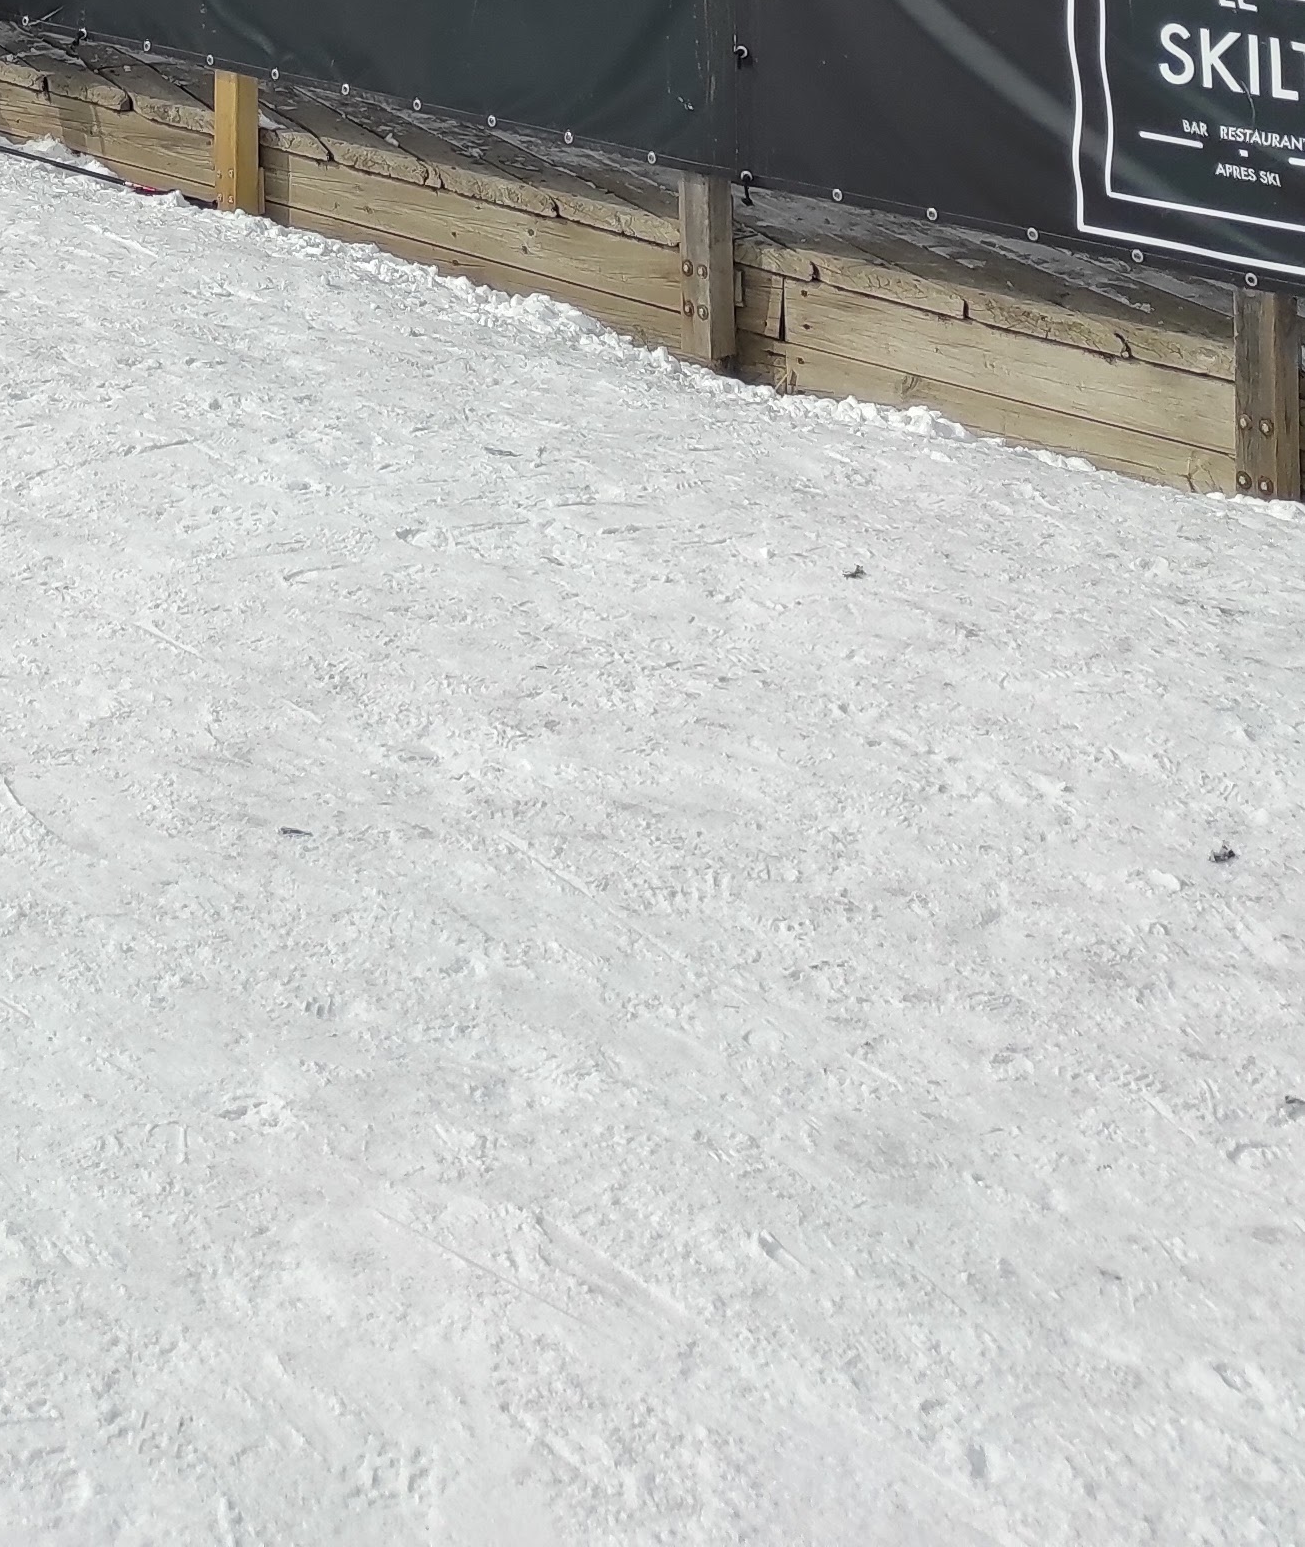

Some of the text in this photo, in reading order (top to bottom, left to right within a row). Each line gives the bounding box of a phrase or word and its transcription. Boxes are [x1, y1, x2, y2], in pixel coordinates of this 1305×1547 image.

[1182, 119, 1305, 152] BAR RESTAURAN
[1215, 162, 1282, 188] APRES SKI
